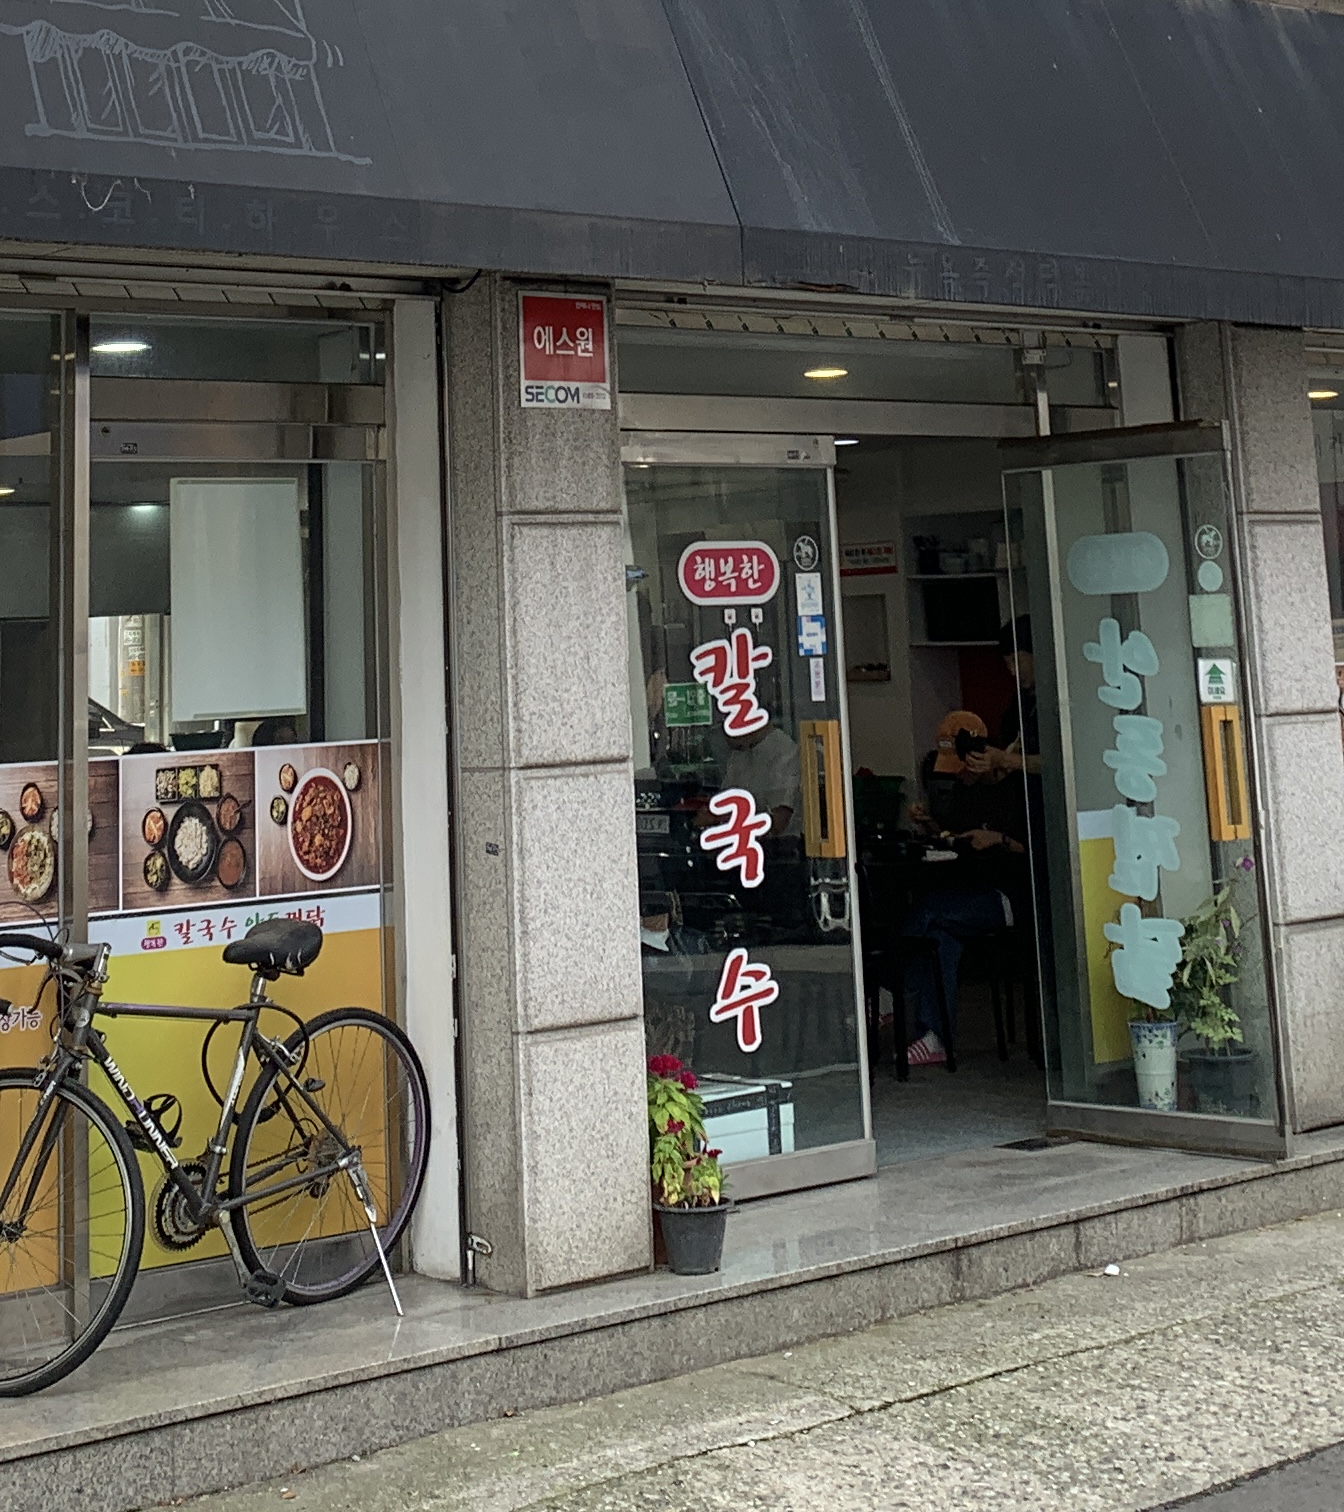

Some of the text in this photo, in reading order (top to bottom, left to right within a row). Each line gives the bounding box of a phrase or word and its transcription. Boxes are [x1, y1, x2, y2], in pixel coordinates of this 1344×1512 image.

[534, 326, 593, 357] 에스원
[525, 385, 580, 404] SECOM
[693, 555, 765, 593] 행복한
[693, 629, 777, 1050] 칼국수
[173, 916, 237, 945] 칼국수
[103, 1056, 178, 1170] WINDRUNNER
